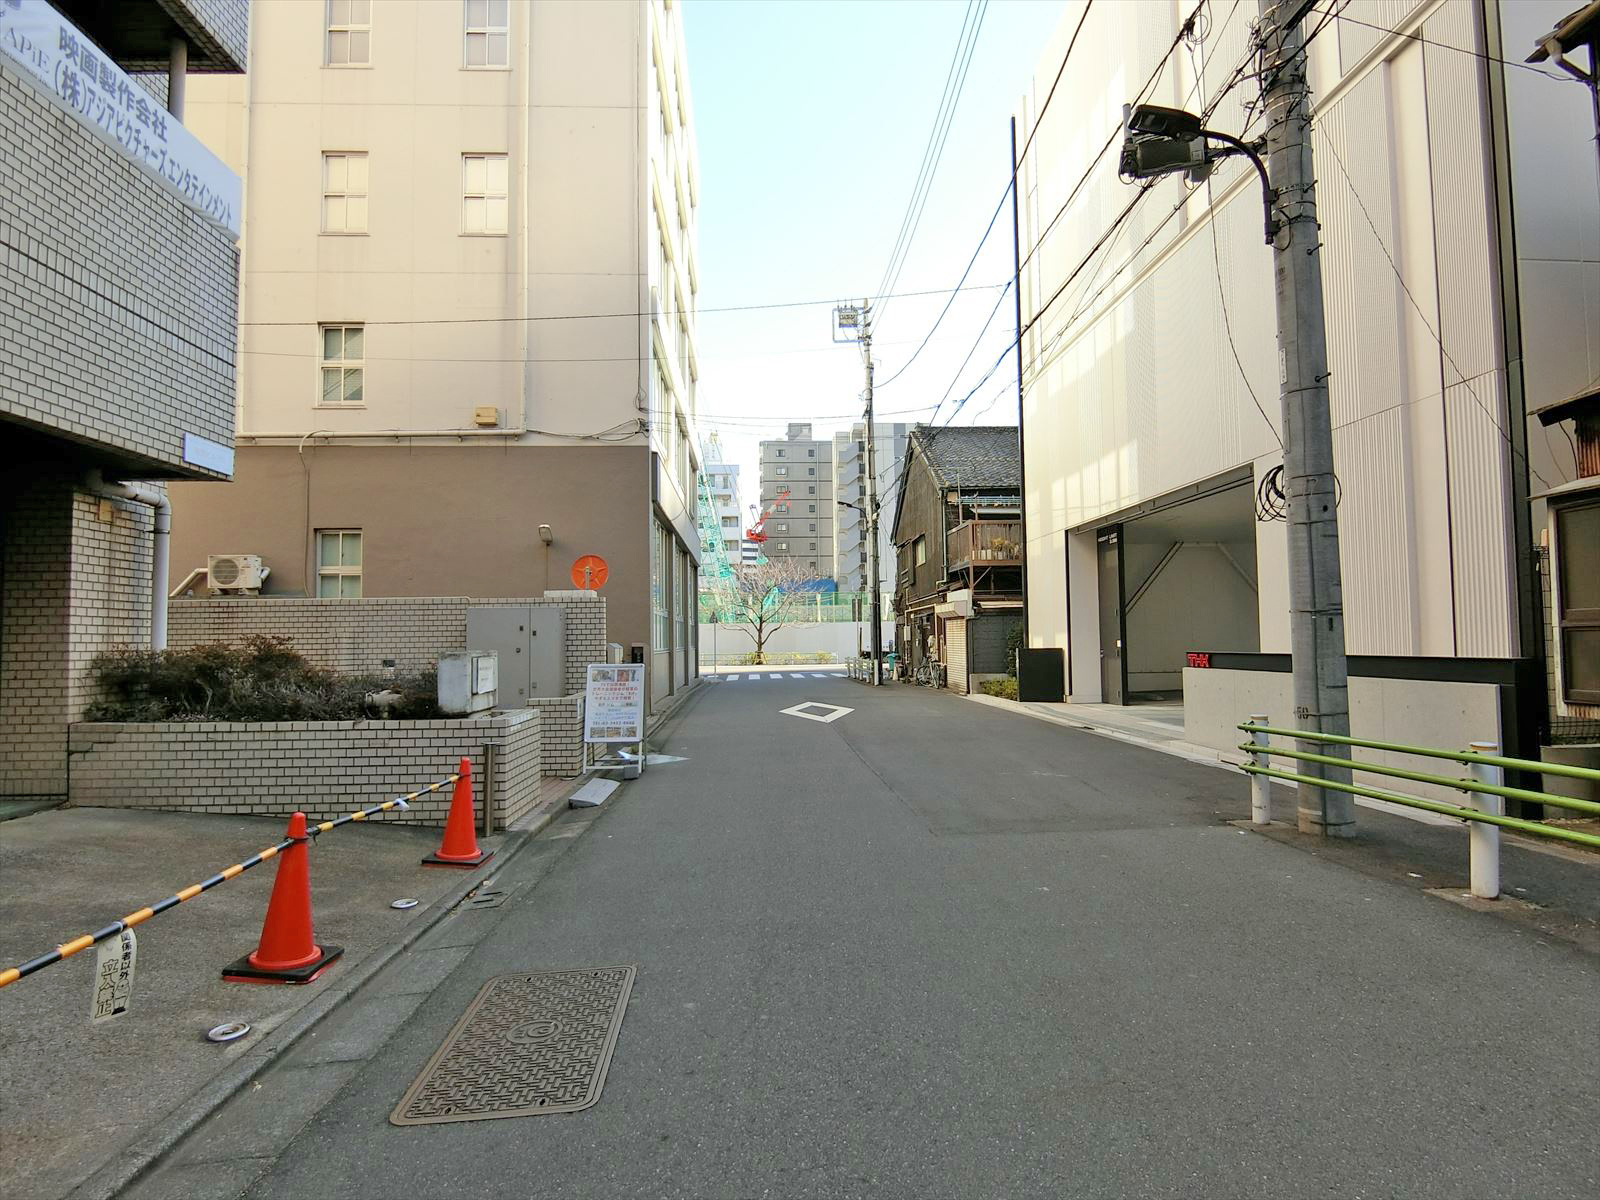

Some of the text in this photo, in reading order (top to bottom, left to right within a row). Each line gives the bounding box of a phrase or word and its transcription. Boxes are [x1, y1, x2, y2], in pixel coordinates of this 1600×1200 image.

[59, 25, 168, 143] 映画製作会社
[119, 932, 132, 980] 関係者以外
